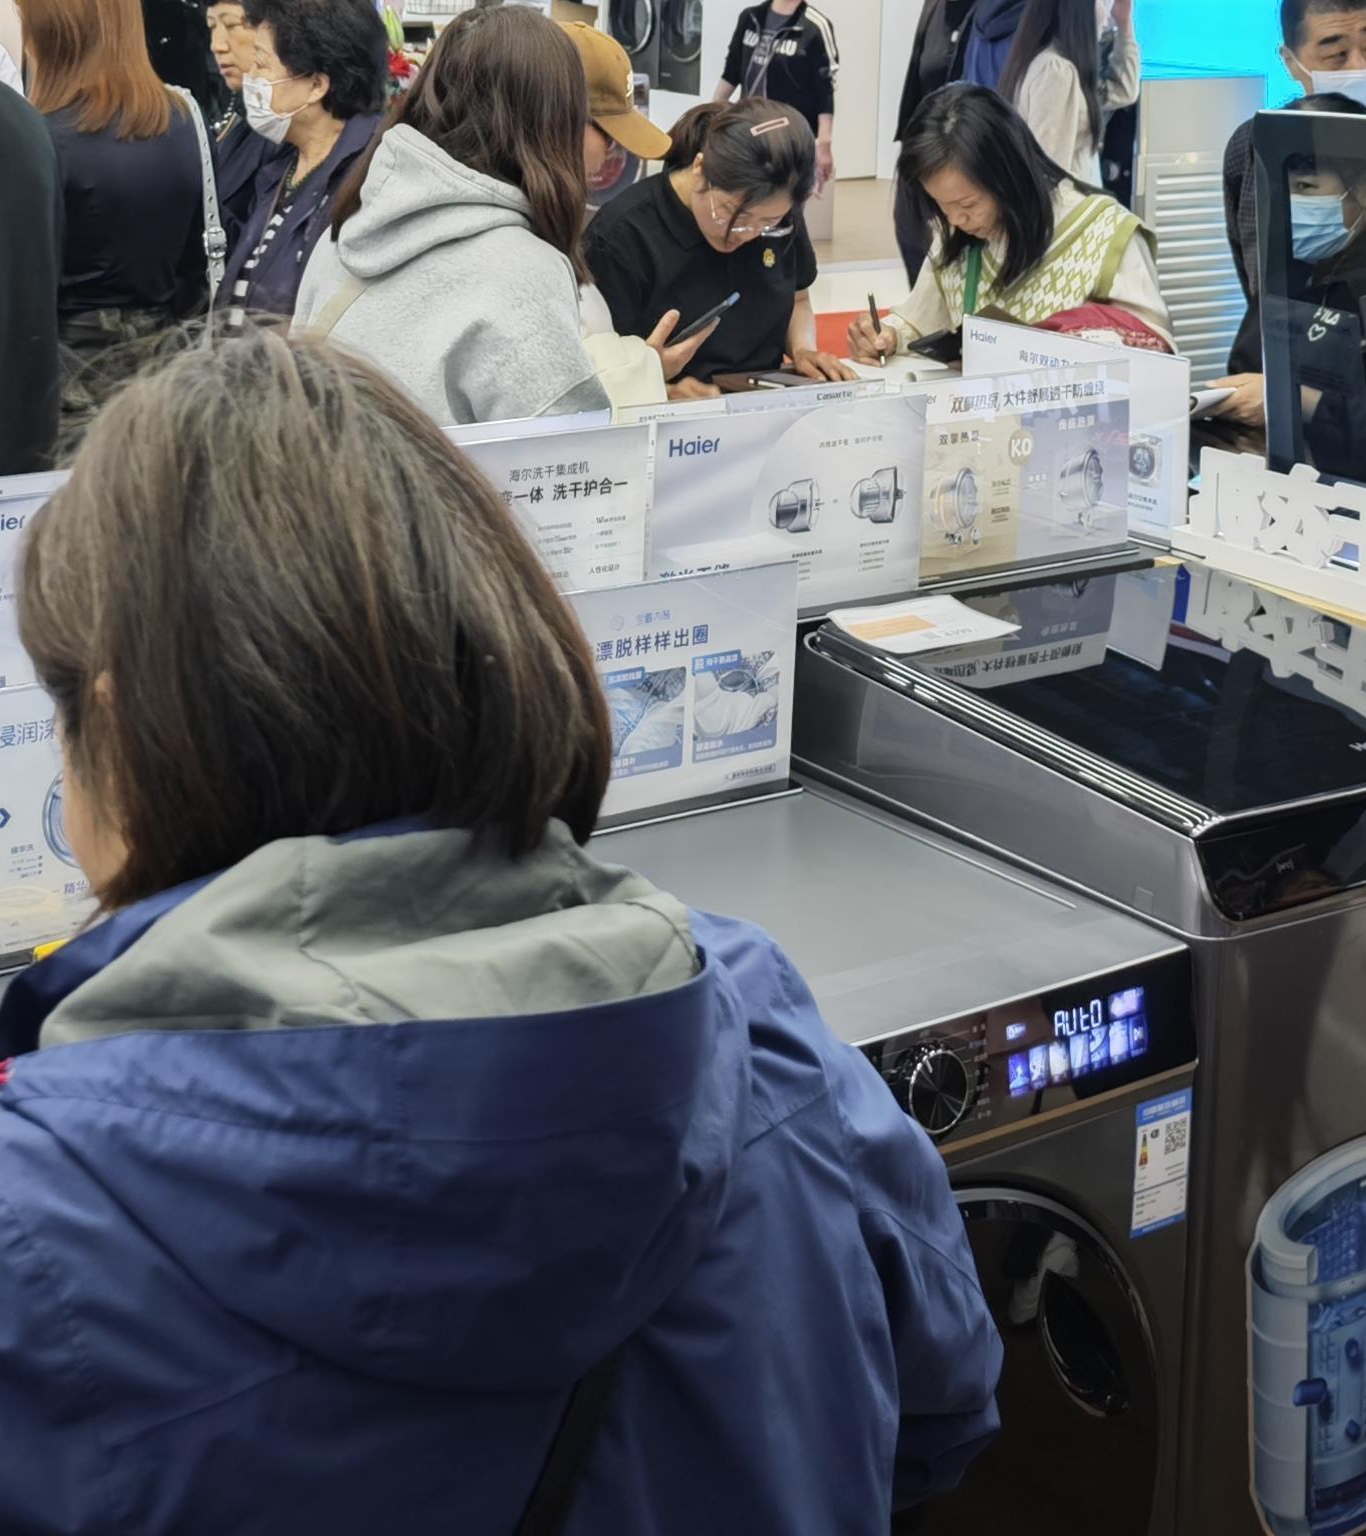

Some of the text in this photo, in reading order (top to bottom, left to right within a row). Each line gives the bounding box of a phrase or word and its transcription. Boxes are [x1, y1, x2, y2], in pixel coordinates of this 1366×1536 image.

[970, 330, 999, 345] Haier
[668, 435, 721, 458] Haier
[1011, 437, 1032, 458] KO
[552, 477, 630, 501] 洗干护合一
